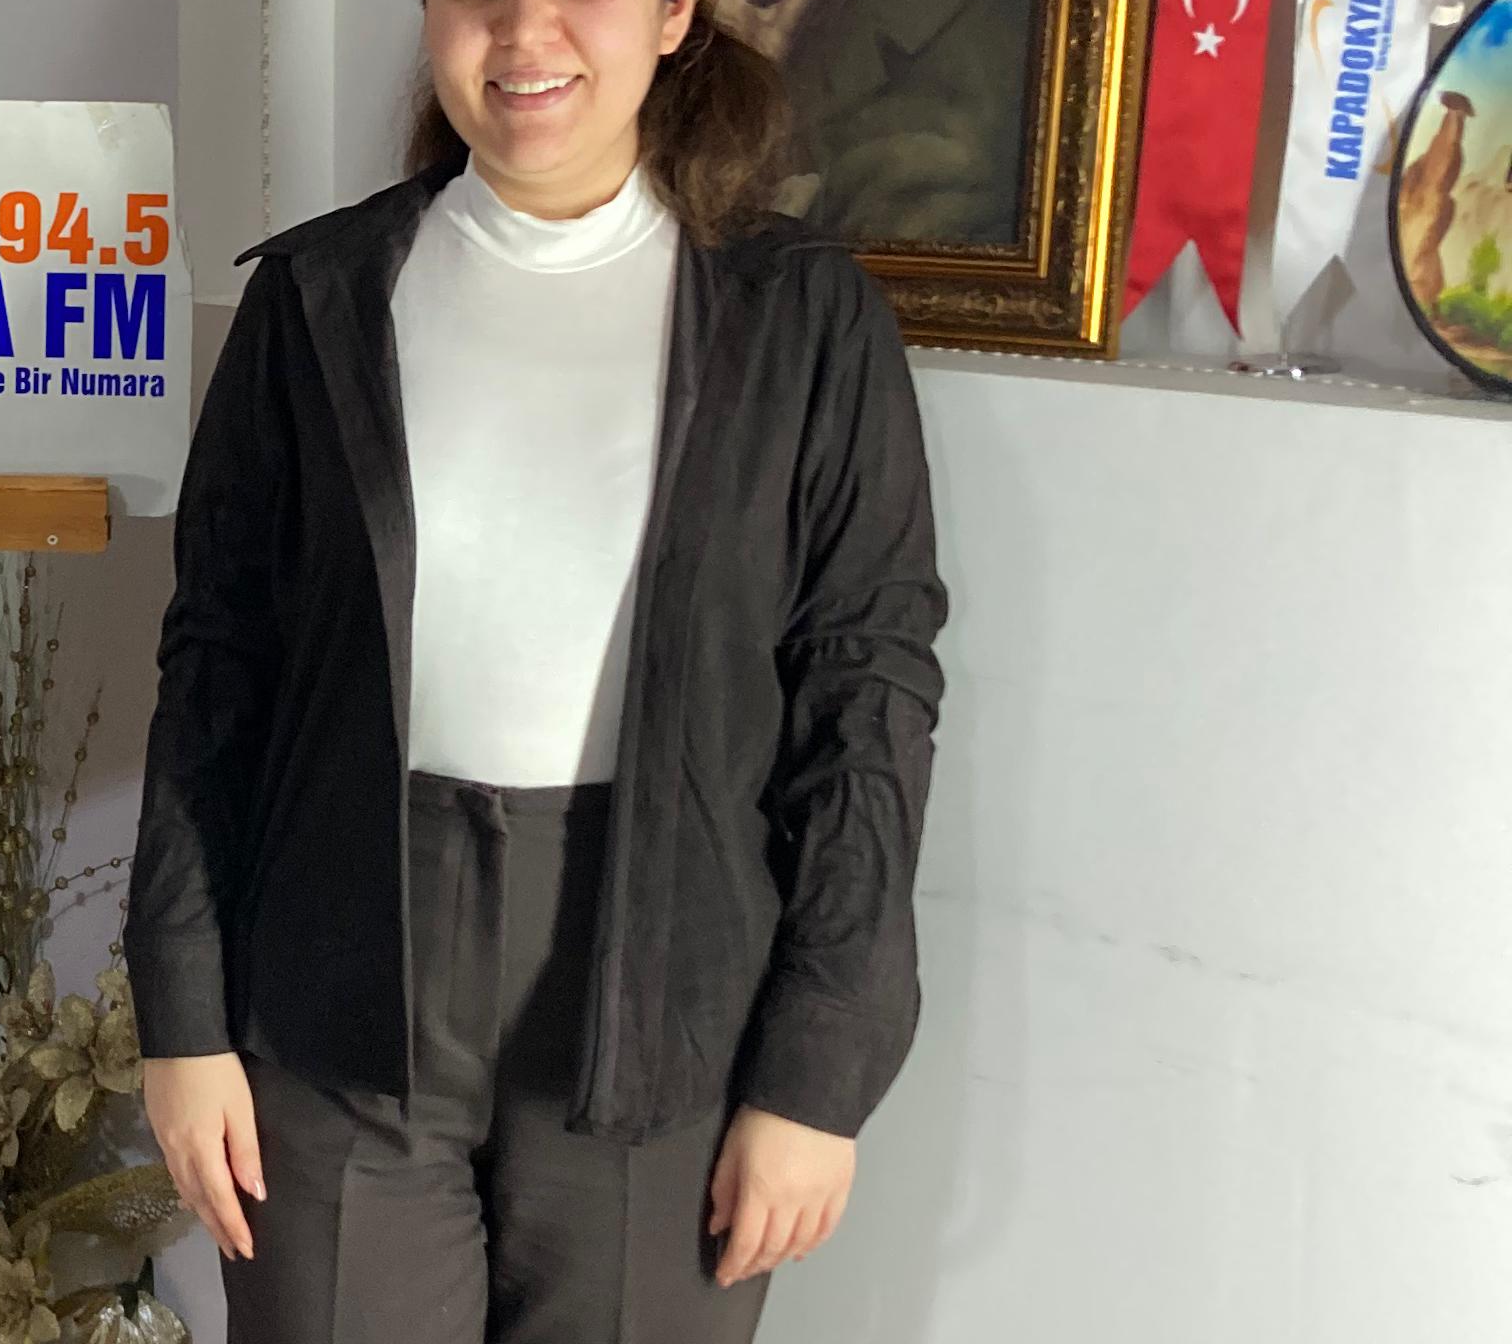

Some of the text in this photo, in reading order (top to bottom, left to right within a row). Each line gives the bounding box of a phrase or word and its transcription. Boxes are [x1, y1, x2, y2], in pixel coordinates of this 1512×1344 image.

[44, 271, 167, 361] FM
[14, 366, 52, 395] Bir
[61, 367, 165, 397] Numara
